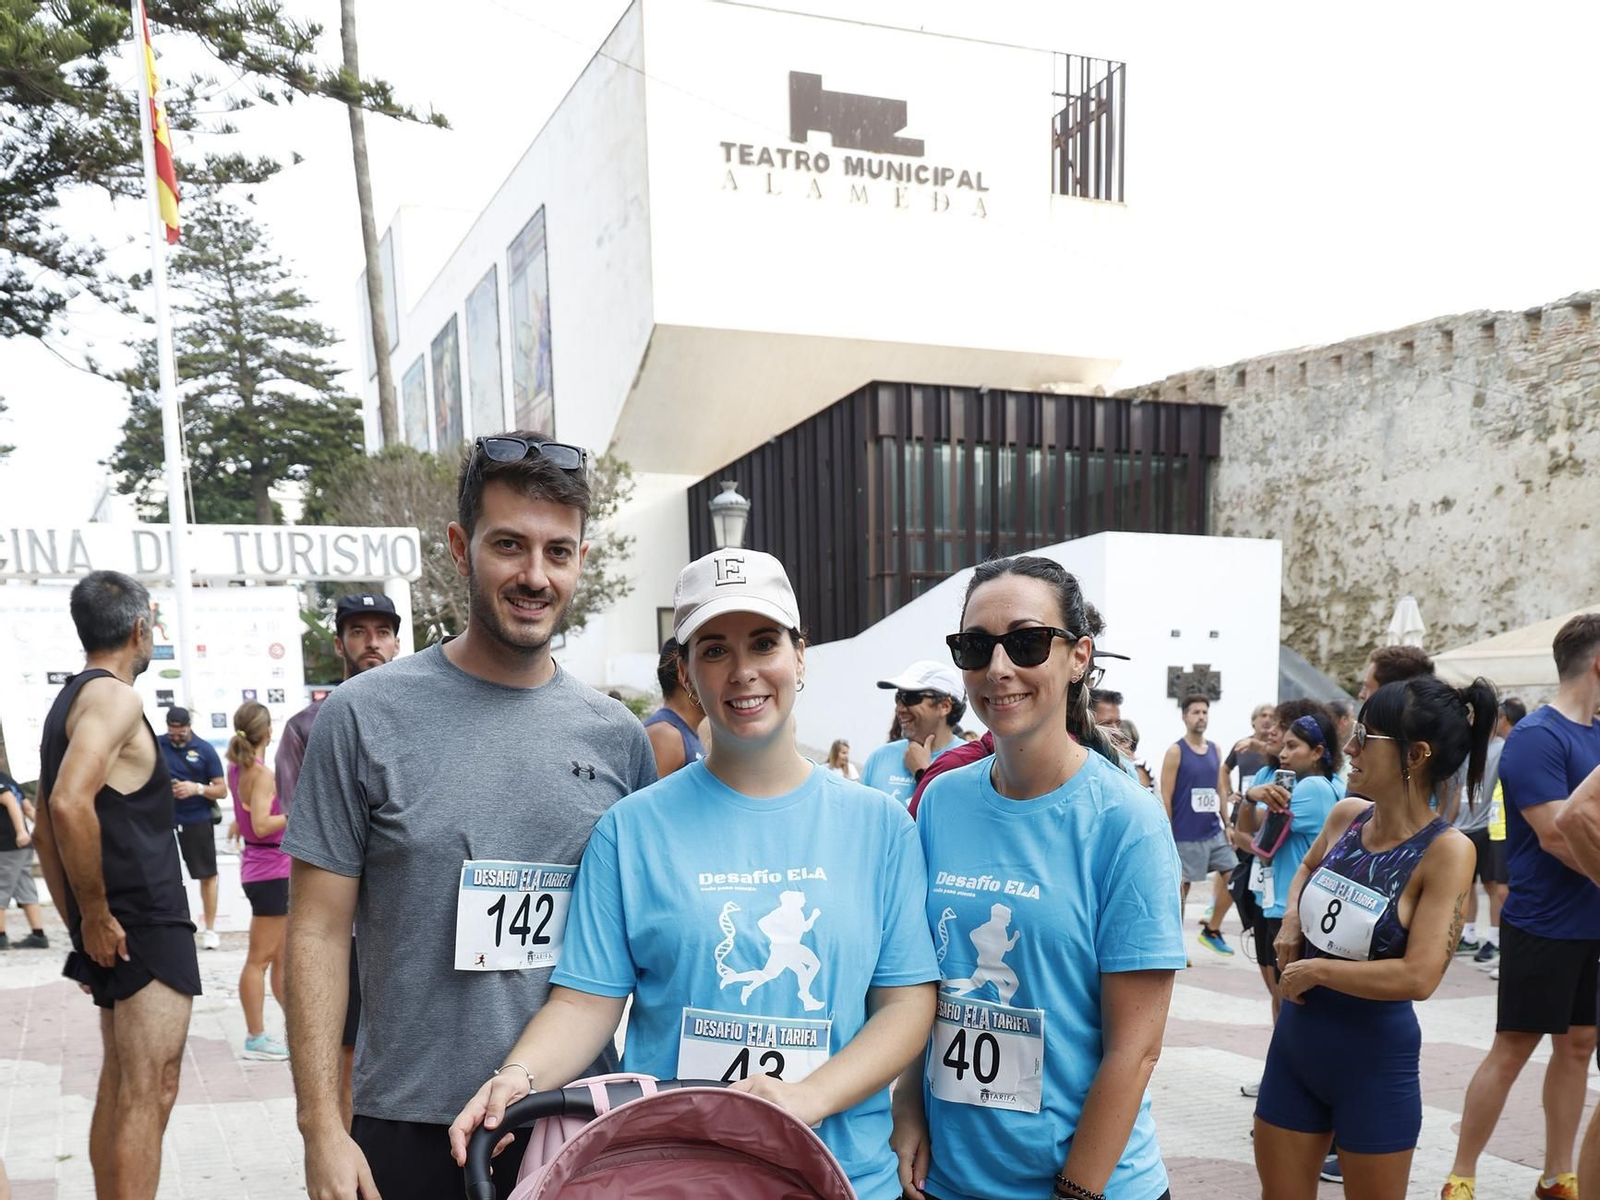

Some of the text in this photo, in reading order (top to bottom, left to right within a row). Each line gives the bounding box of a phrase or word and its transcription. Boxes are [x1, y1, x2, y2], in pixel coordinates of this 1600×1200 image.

[720, 141, 990, 192] TEATRO MUNICIPAL
[722, 168, 988, 219] ALAMEDA
[223, 531, 417, 576] TURISMO
[714, 556, 747, 587] E
[474, 868, 573, 892] DESAFÍO ELA TARIFA
[698, 866, 828, 885] Desafío ELA
[935, 871, 1040, 900] Desafío ELA
[1321, 898, 1342, 934] 8
[1352, 890, 1378, 910] TARIFA
[487, 893, 554, 948] 142
[937, 1000, 1031, 1033] SAFÍO ELA TARIFA
[694, 1018, 818, 1048] DESAFÍO ELA TARIFA
[943, 1028, 1000, 1084] 40
[990, 1092, 1017, 1103] TARIFA
